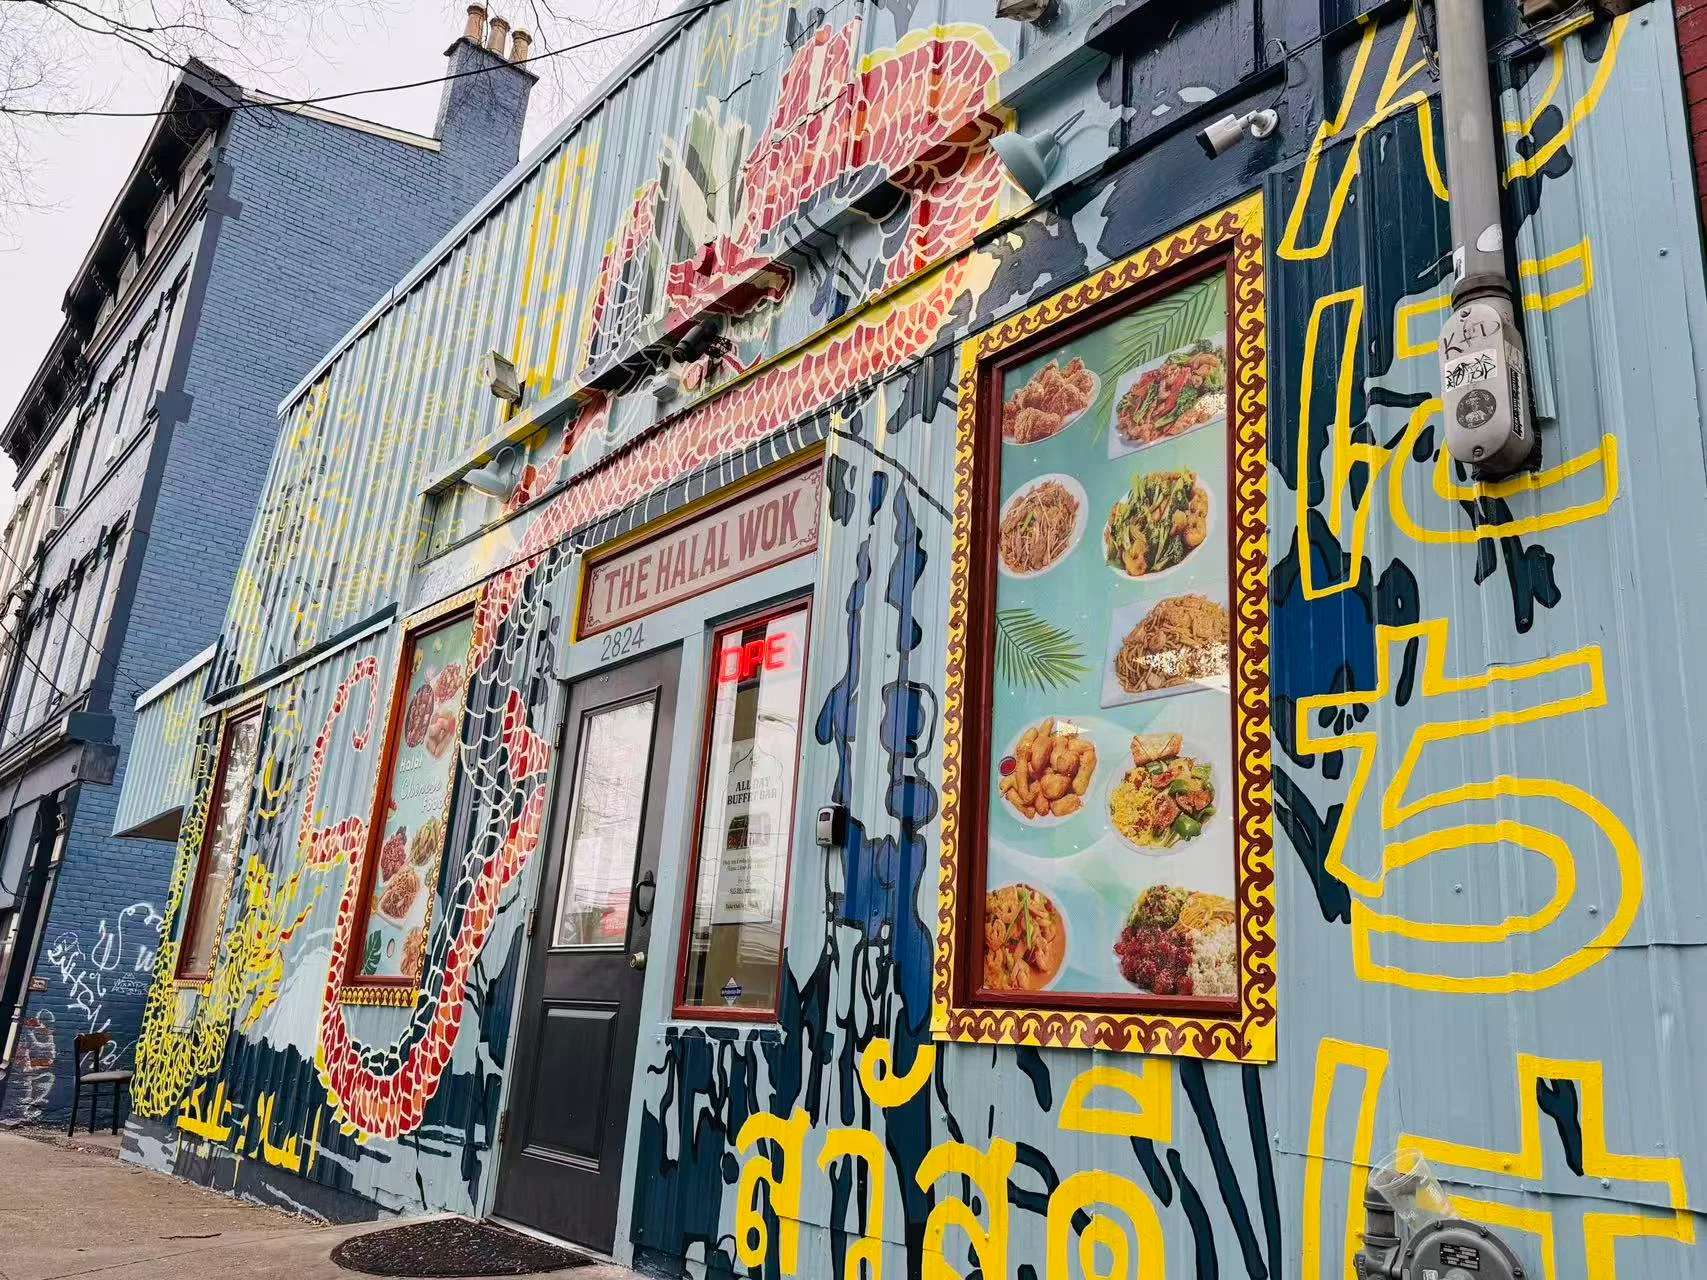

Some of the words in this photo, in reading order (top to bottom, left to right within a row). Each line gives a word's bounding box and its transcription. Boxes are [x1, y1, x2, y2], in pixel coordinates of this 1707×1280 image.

[604, 554, 652, 614] THE
[654, 521, 730, 595] HALAL
[737, 488, 801, 561] WOK
[600, 622, 645, 662] 2824
[399, 753, 424, 773] Halal
[735, 779, 751, 792] ALL
[727, 790, 759, 806] BUFFET
